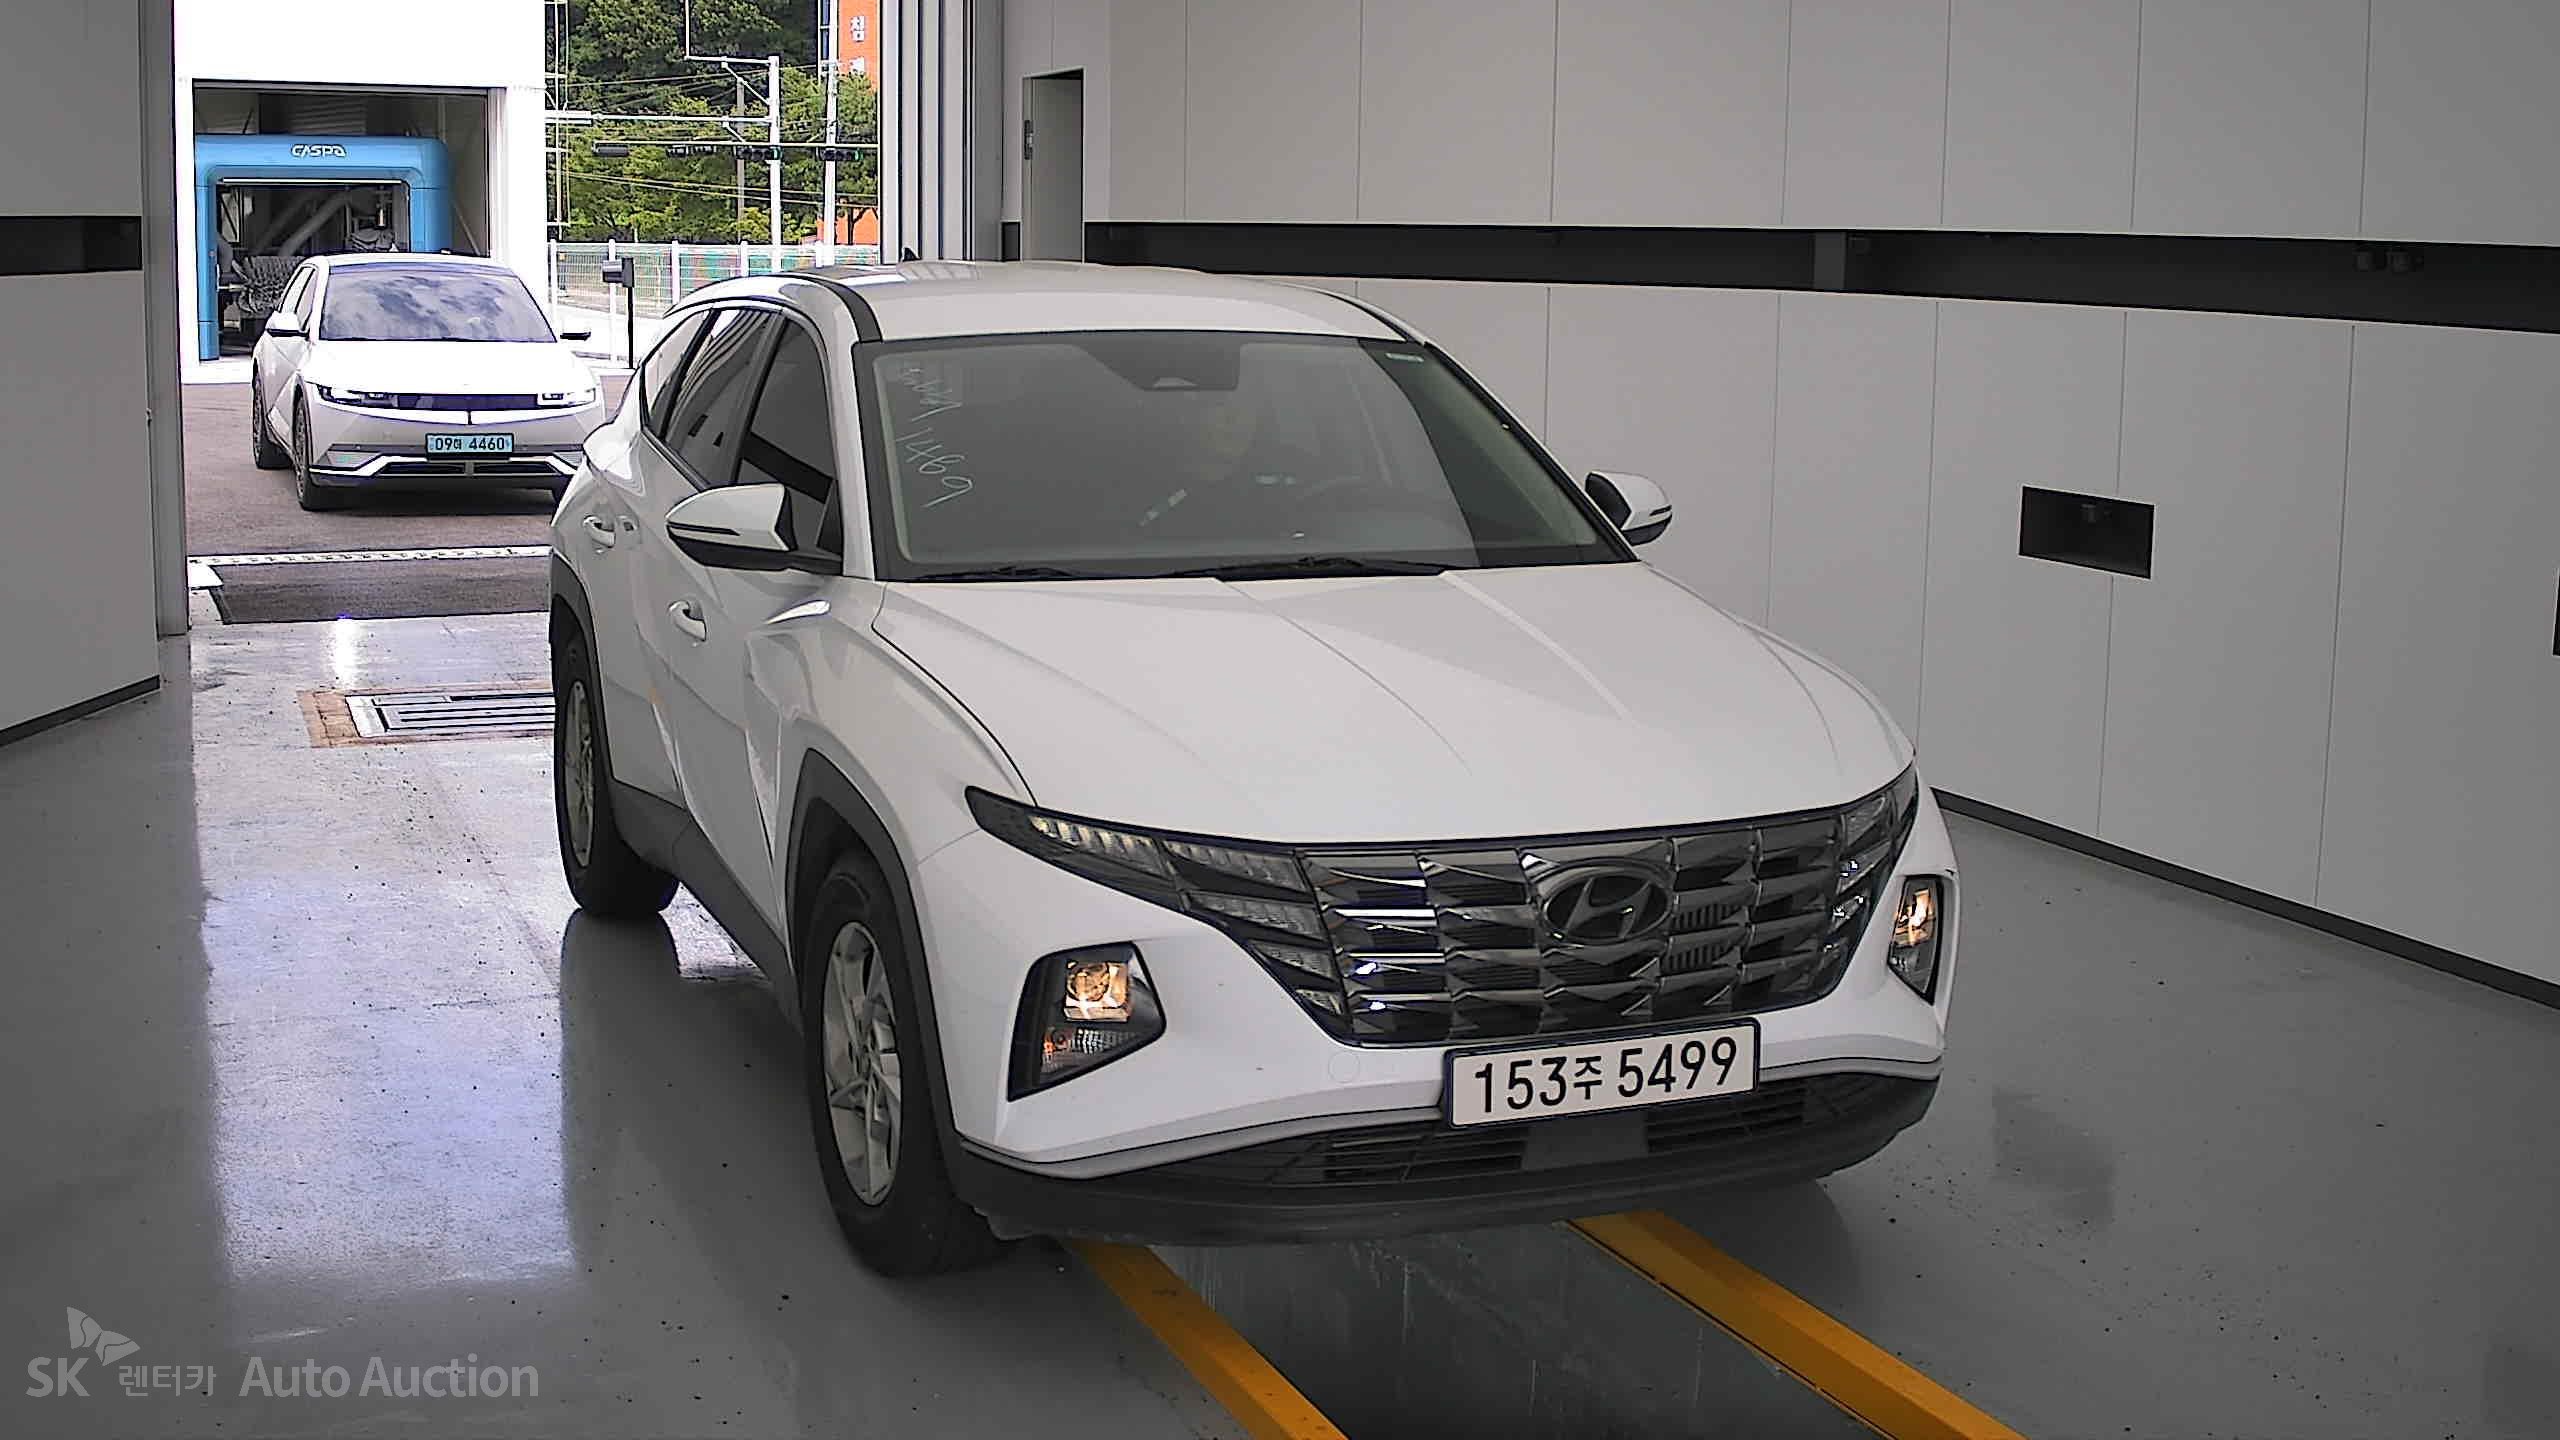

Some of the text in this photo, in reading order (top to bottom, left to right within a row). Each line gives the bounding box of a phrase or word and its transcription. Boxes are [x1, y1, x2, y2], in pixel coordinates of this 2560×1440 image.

[468, 437, 505, 451] 4460
[1474, 1036, 1738, 1113] 153주 5499
